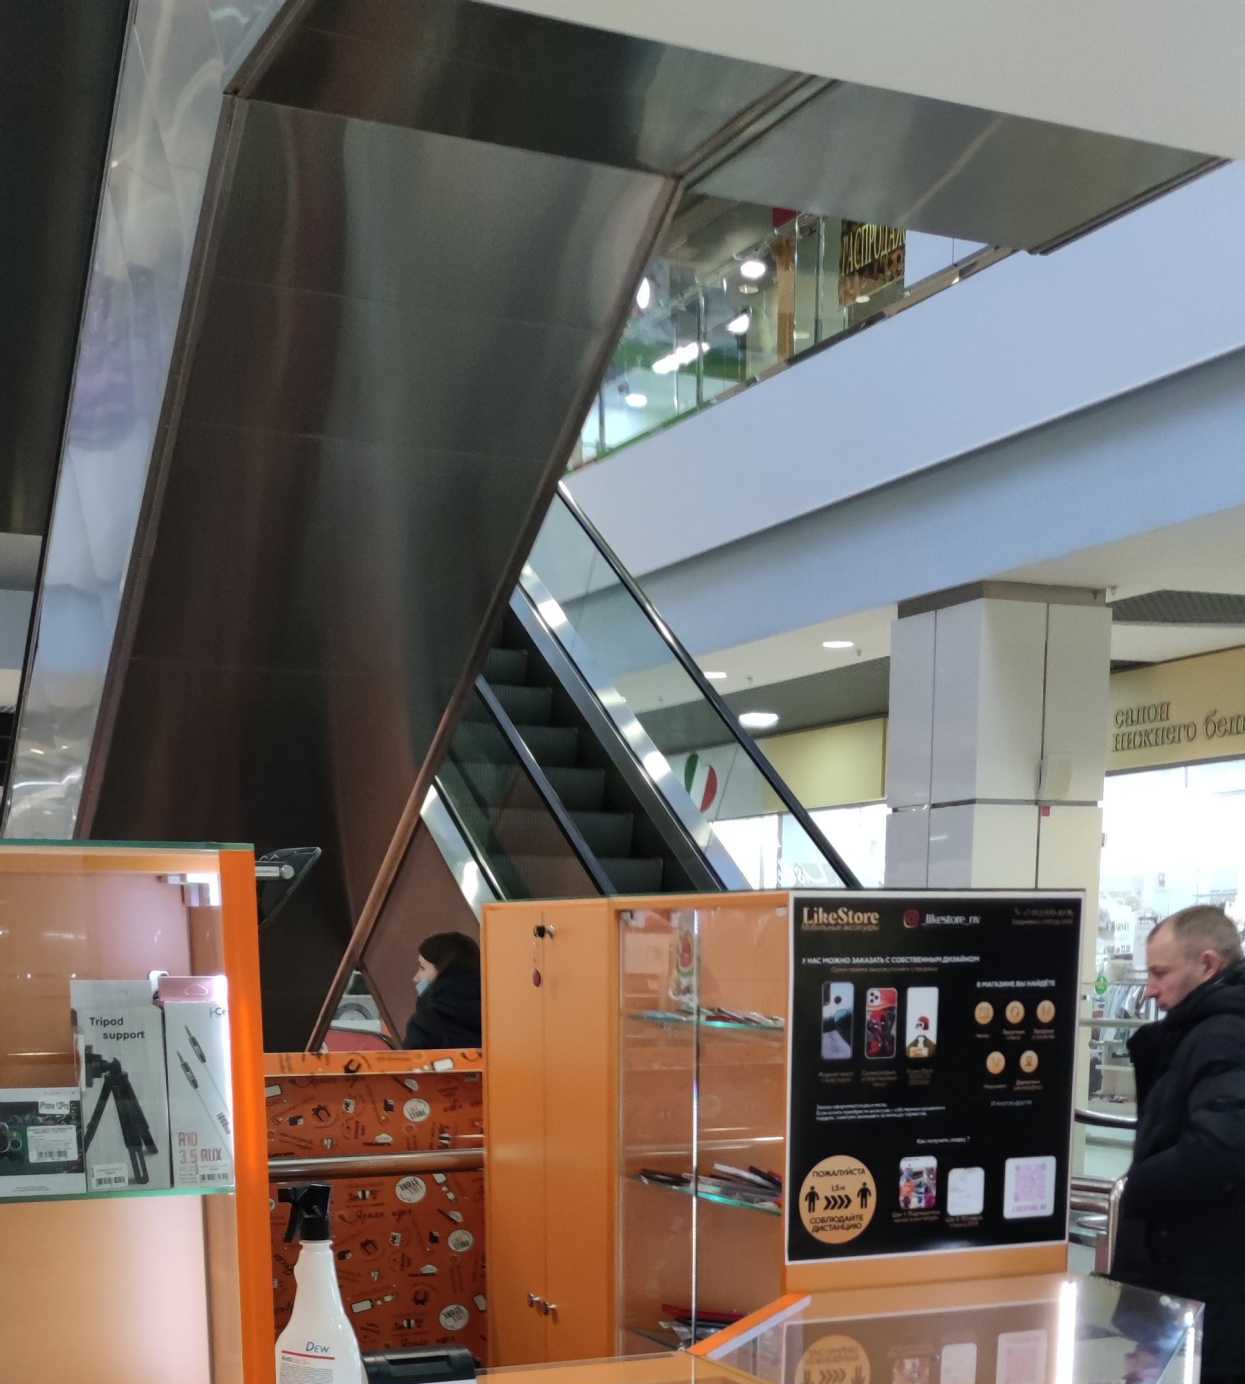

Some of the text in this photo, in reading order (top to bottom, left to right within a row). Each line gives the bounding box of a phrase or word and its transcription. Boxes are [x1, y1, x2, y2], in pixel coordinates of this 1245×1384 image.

[1114, 701, 1171, 729] салон
[1112, 720, 1198, 752] нижнего
[802, 906, 880, 925] LikeStore
[89, 1016, 124, 1028] Tripod
[103, 1030, 145, 1041] support
[812, 1167, 866, 1178] ПОЖАЛУЙСТА
[809, 1214, 864, 1225] СОБЛЮДАЙТЕ
[811, 1222, 863, 1233] ДИСТАНЦИЮ
